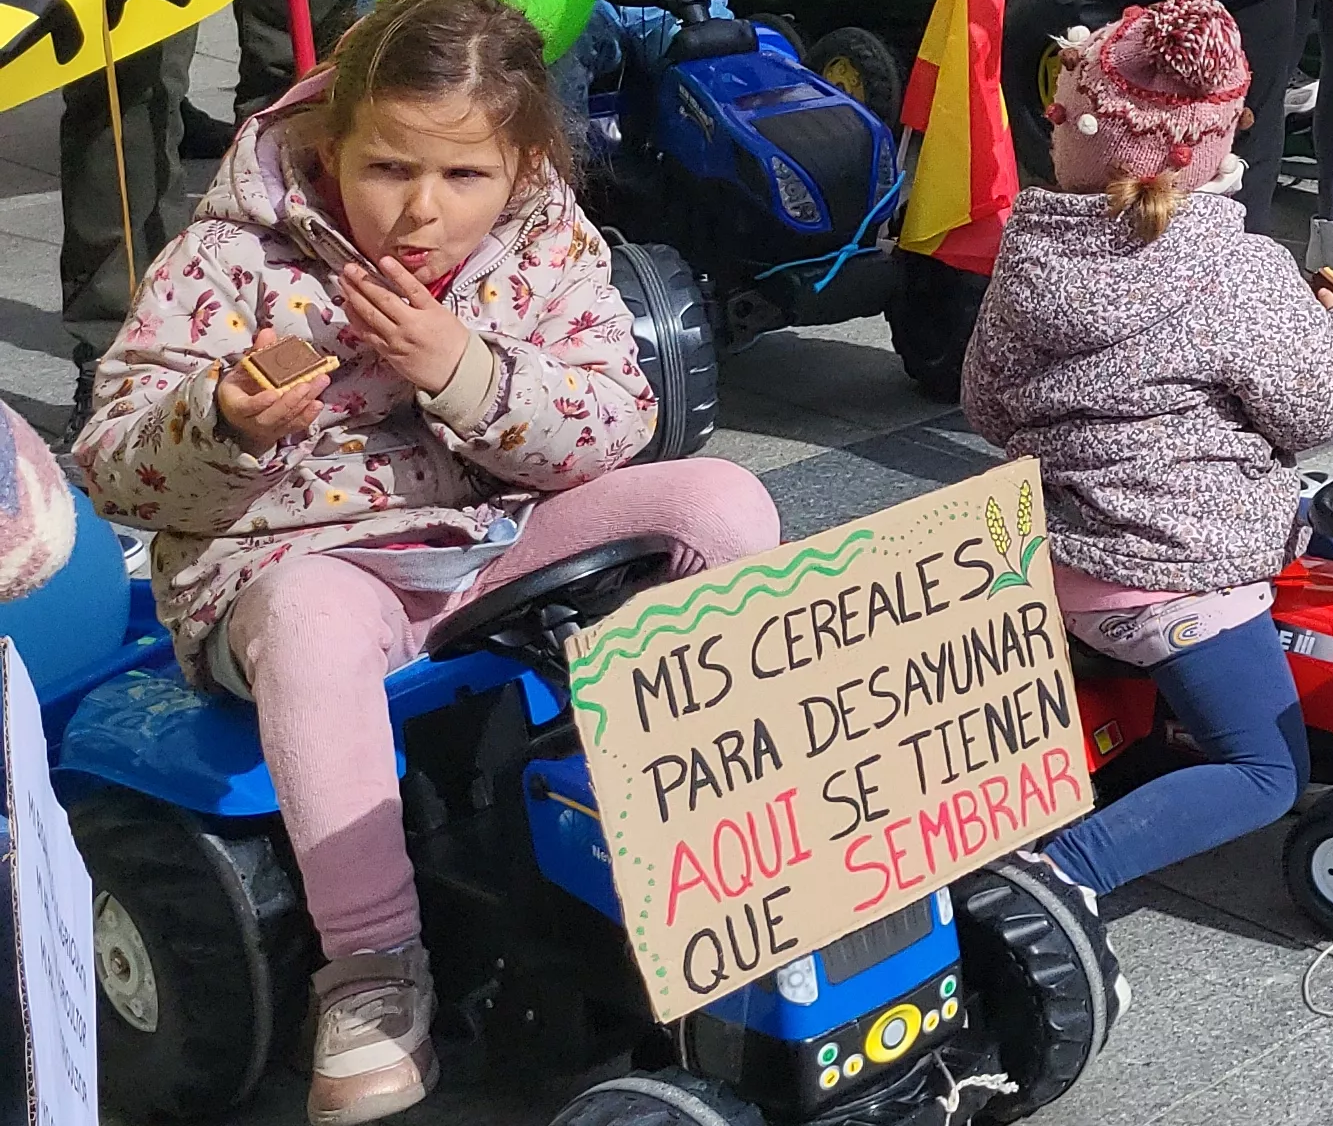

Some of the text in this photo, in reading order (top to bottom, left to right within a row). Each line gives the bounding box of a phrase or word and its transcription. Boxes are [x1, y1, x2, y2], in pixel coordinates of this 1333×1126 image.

[632, 538, 994, 733] MIS CEREALES
[642, 601, 1055, 823] PARA DESAYUNAR
[666, 669, 1071, 927] AQUI SE TIENEN
[683, 747, 1081, 995] QUE SEMBRAR
